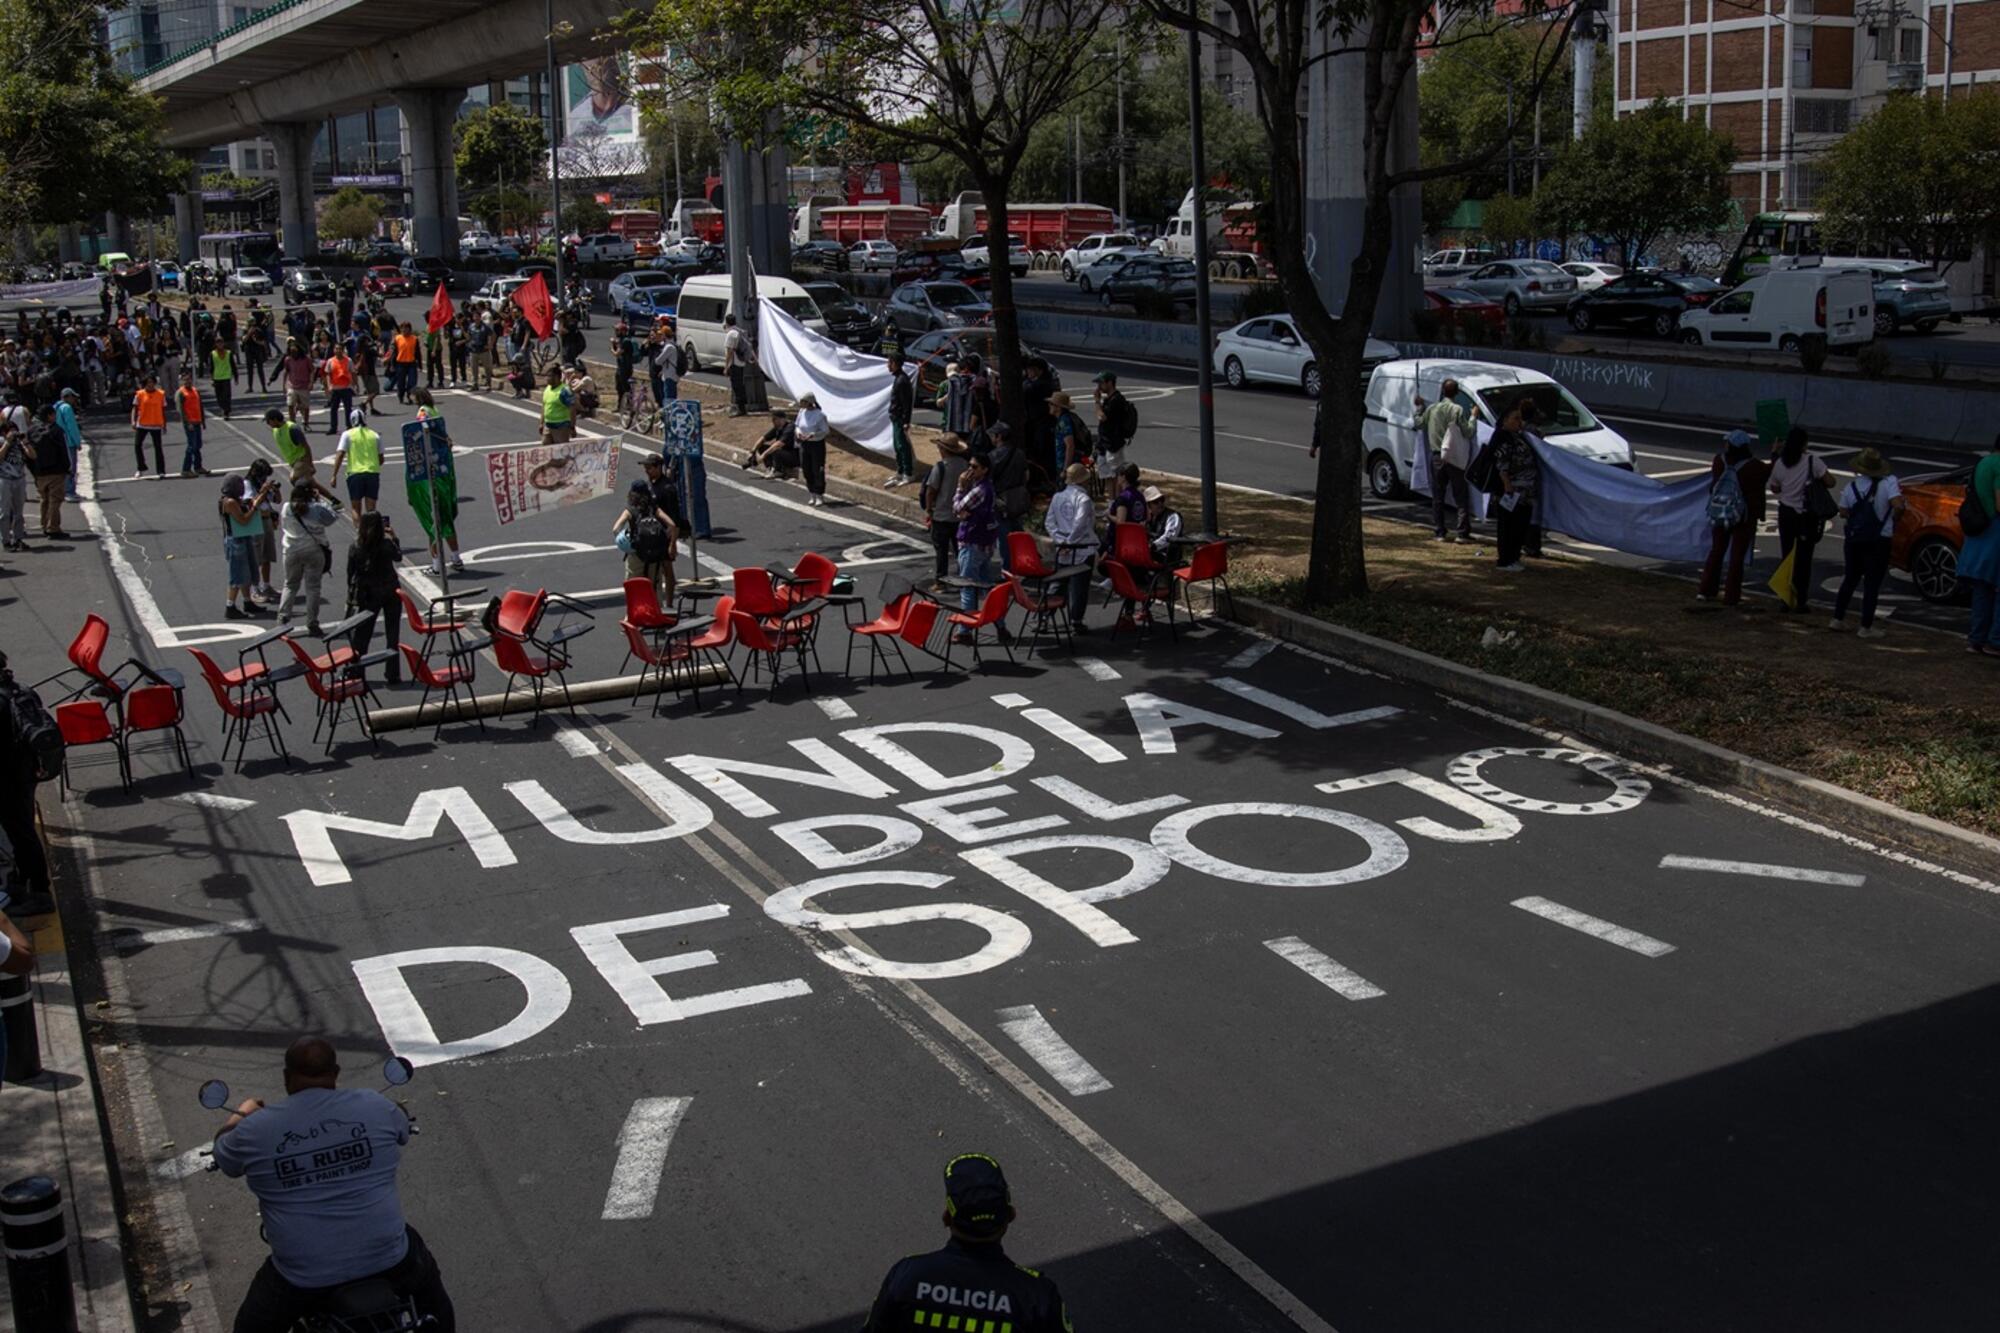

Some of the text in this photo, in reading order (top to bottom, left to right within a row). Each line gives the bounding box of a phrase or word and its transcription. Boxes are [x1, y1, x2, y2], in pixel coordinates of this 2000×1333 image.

[491, 454, 511, 521] CLARA
[769, 774, 1191, 869] DEL
[352, 745, 1652, 1067] DESPOJO
[280, 1143, 365, 1175] EL RUSO
[315, 1167, 345, 1182] PAINT
[348, 1160, 371, 1174] SHOP
[916, 1281, 1012, 1314] POLICÍA
